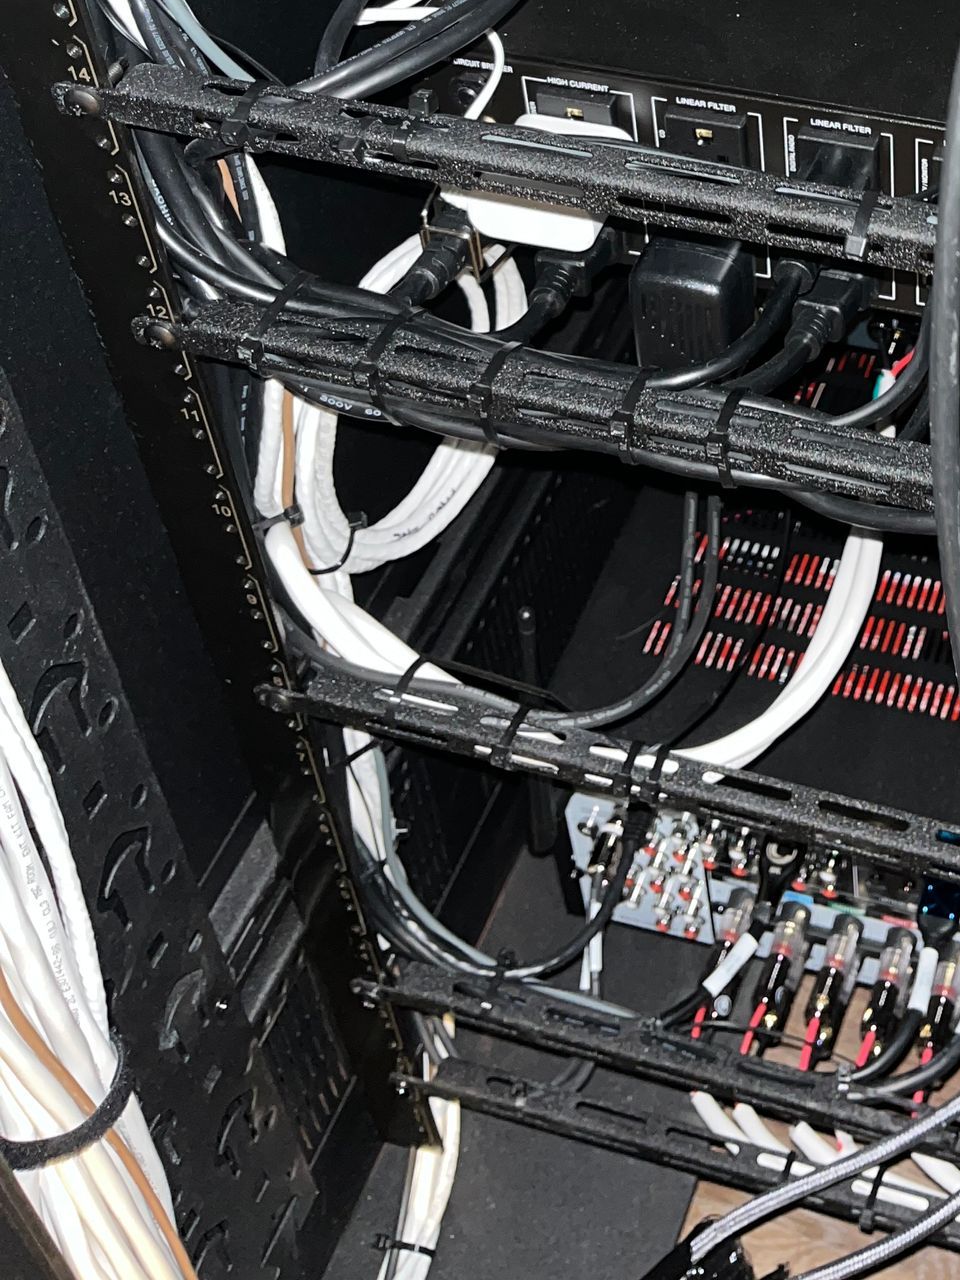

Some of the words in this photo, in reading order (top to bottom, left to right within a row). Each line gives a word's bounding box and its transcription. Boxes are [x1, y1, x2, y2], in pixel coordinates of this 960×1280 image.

[67, 65, 91, 83] 14
[546, 76, 567, 88] HIGH
[568, 78, 610, 93] CURRENT
[675, 96, 706, 108] LINEAR
[707, 100, 736, 113] FILTER
[809, 117, 840, 132] LINEAR
[842, 121, 872, 135] FILTER
[108, 190, 132, 207] 13
[146, 303, 169, 320] 12
[180, 407, 200, 423] 11
[211, 503, 232, 517] 10
[245, 594, 258, 606] 9
